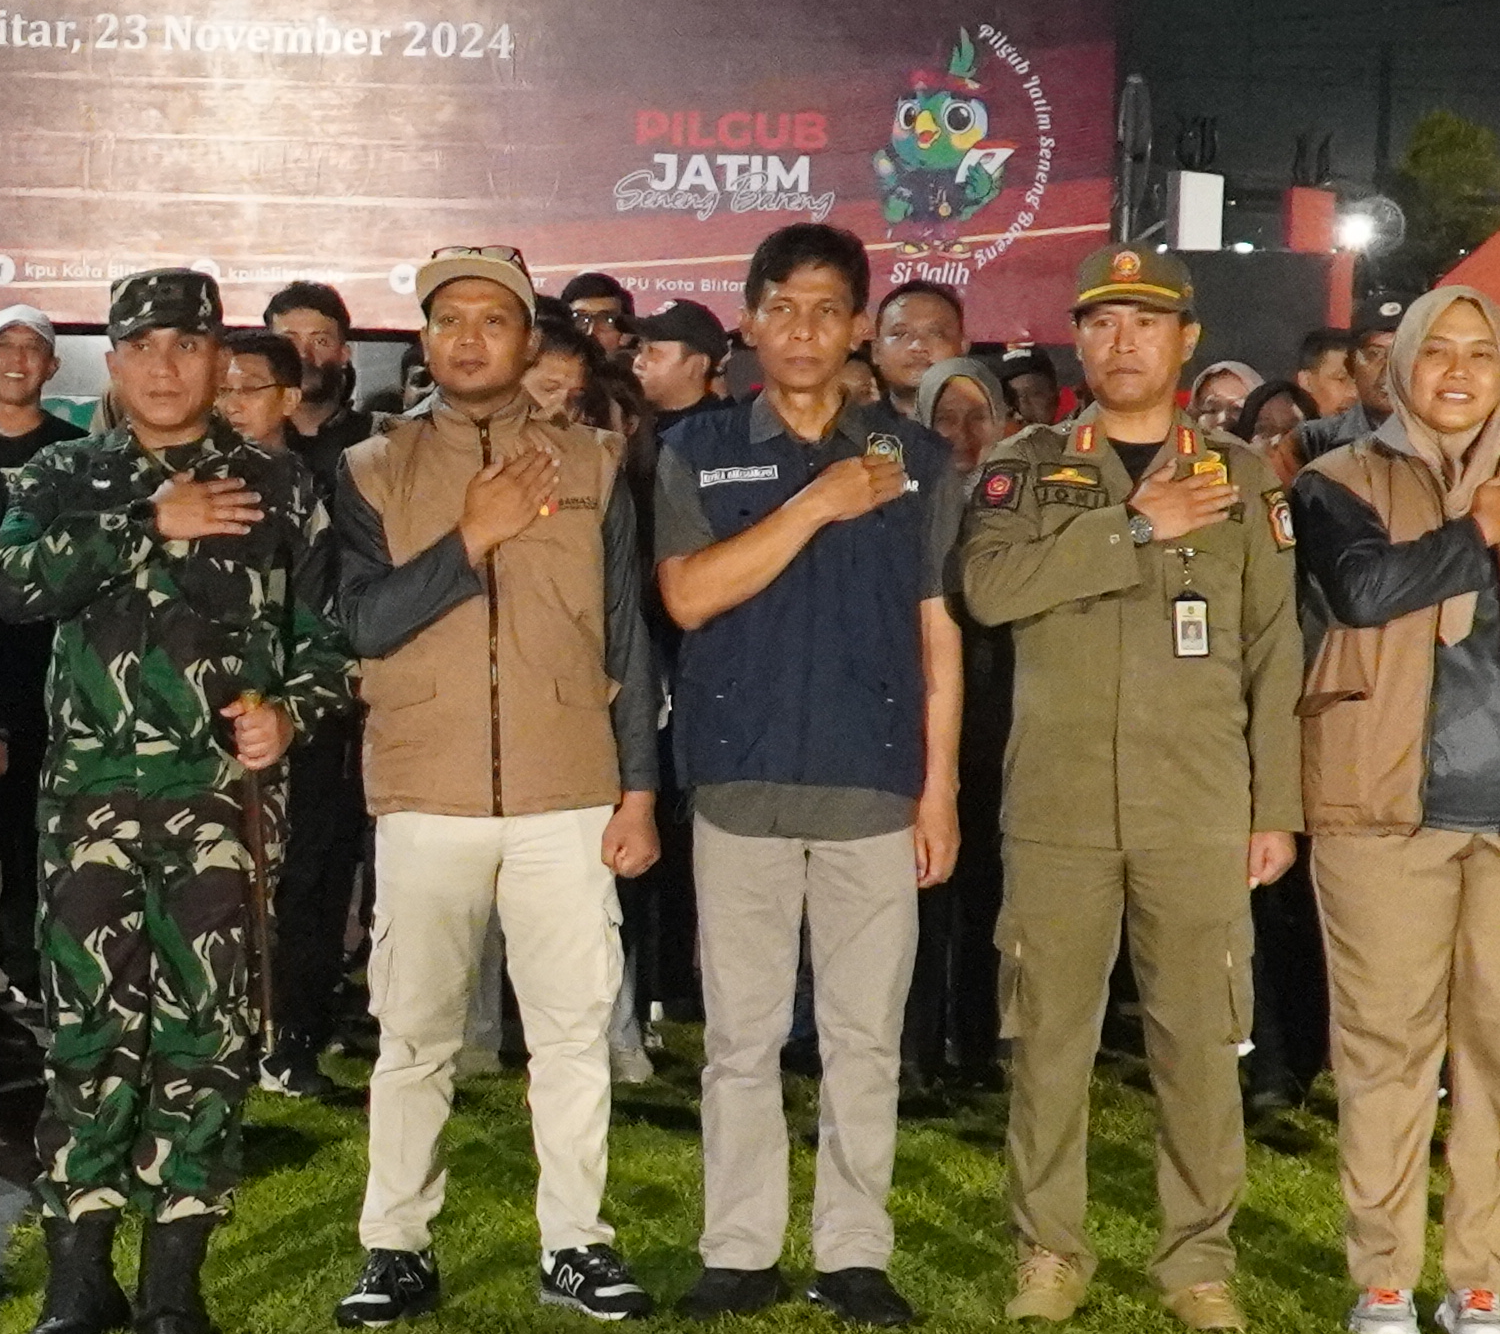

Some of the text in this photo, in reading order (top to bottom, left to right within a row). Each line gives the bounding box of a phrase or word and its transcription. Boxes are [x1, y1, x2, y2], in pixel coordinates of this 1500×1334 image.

[94, 13, 148, 51] 23
[163, 15, 392, 57] November
[403, 20, 514, 59] 2024
[635, 109, 828, 149] PILGUB
[973, 23, 1055, 270] Pilgub Jatim Seneng Bareng
[650, 153, 811, 193] JATIM
[613, 169, 836, 222] Seneng Bareng
[62, 264, 103, 278] Kota
[656, 278, 694, 292] Kota
[701, 278, 747, 292] Blitar
